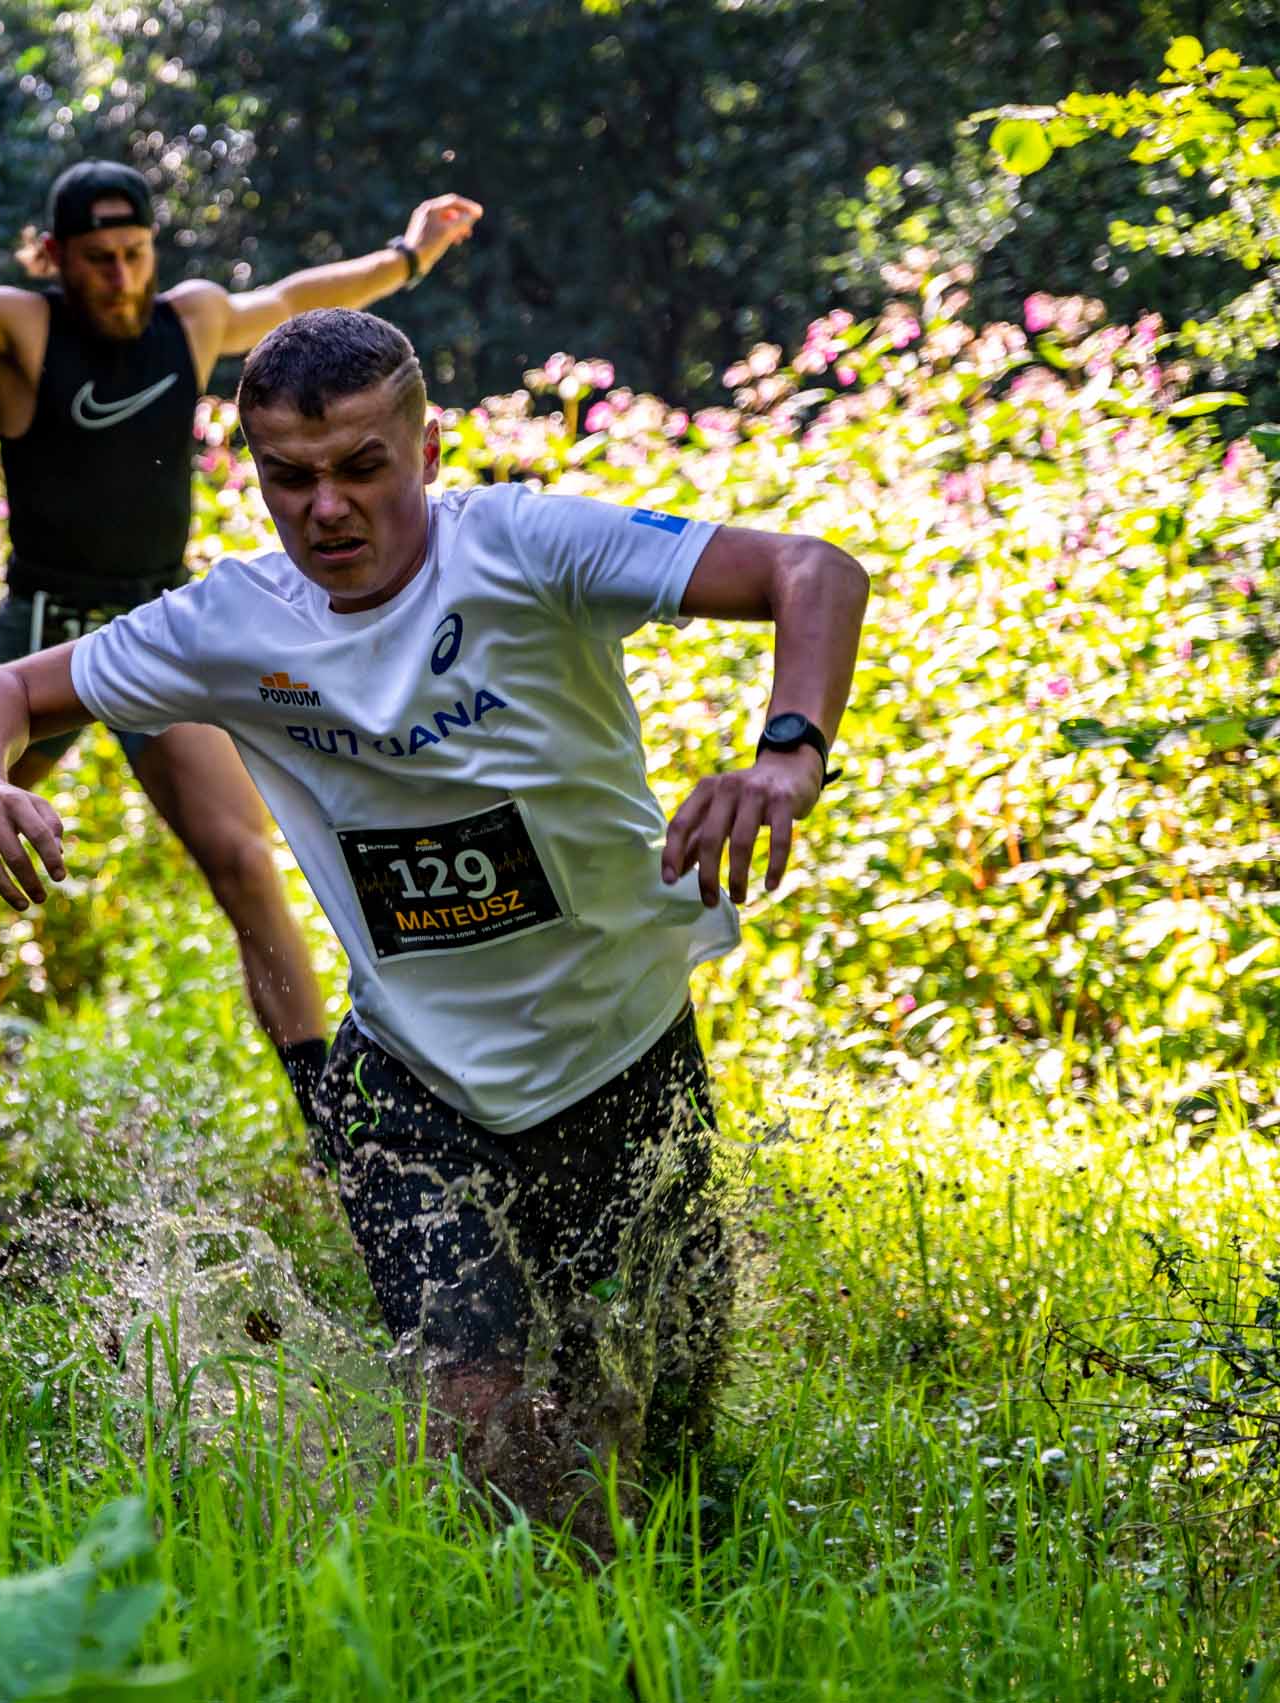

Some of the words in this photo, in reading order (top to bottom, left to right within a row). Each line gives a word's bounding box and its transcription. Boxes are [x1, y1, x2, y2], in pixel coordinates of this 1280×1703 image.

[258, 686, 321, 707] PODIUM
[286, 688, 508, 758] BUTJANA
[388, 849, 497, 899] 129
[394, 889, 525, 931] MATEUSZ
